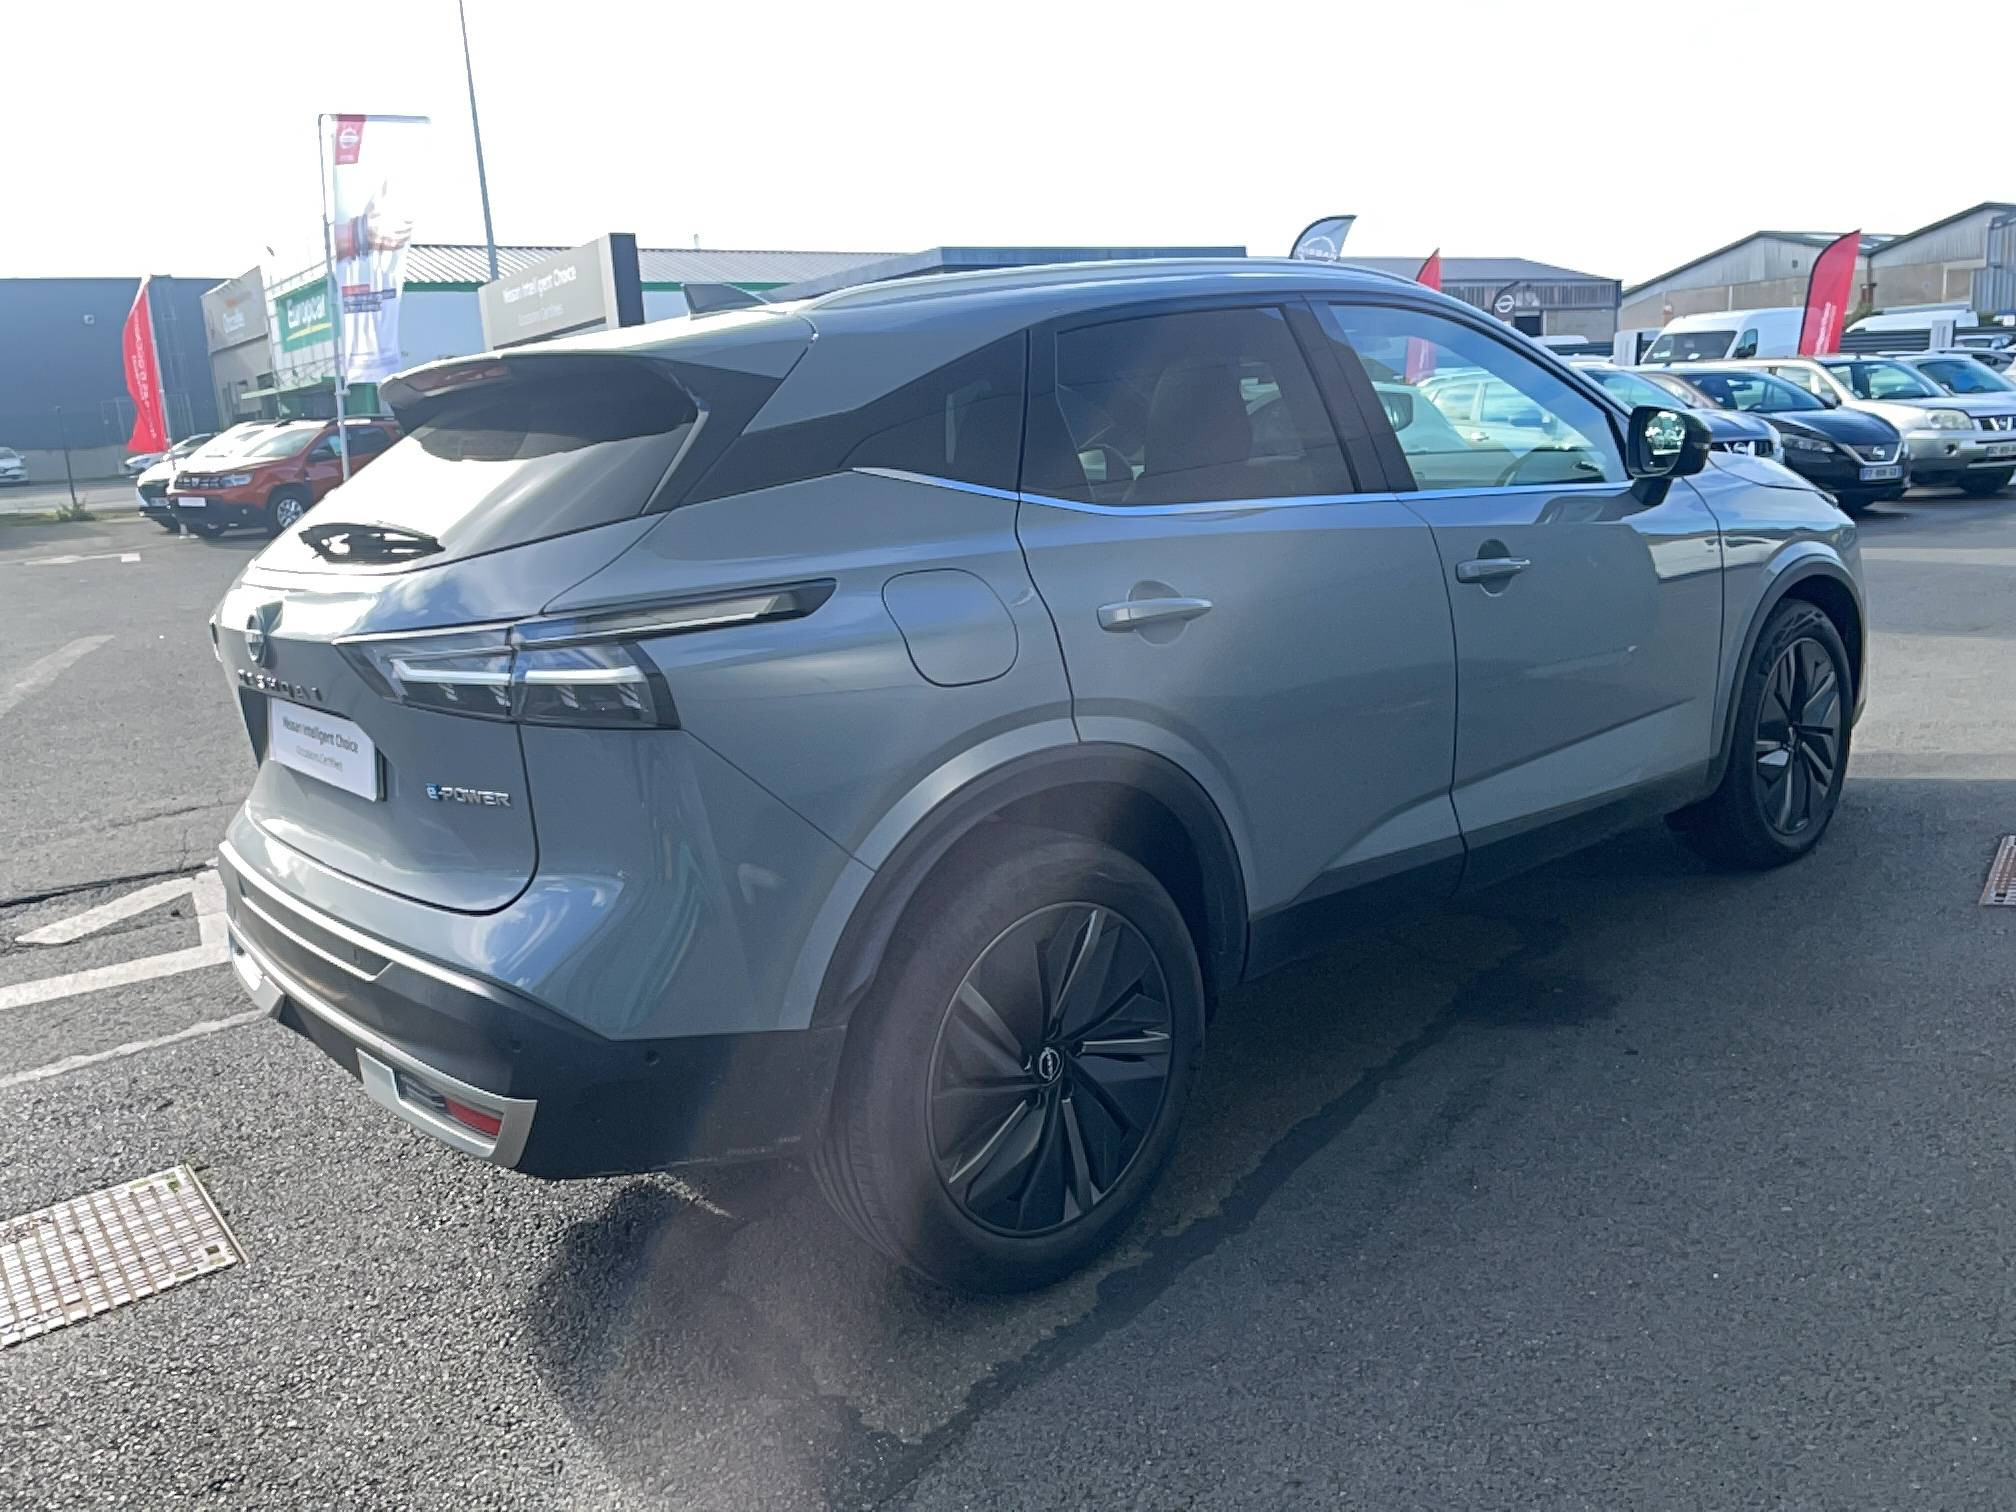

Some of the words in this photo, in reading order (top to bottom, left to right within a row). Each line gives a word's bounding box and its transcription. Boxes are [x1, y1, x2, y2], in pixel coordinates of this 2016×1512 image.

[286, 293, 326, 328] Europcar
[303, 725, 335, 746] Intelligent
[335, 734, 359, 753] Choice
